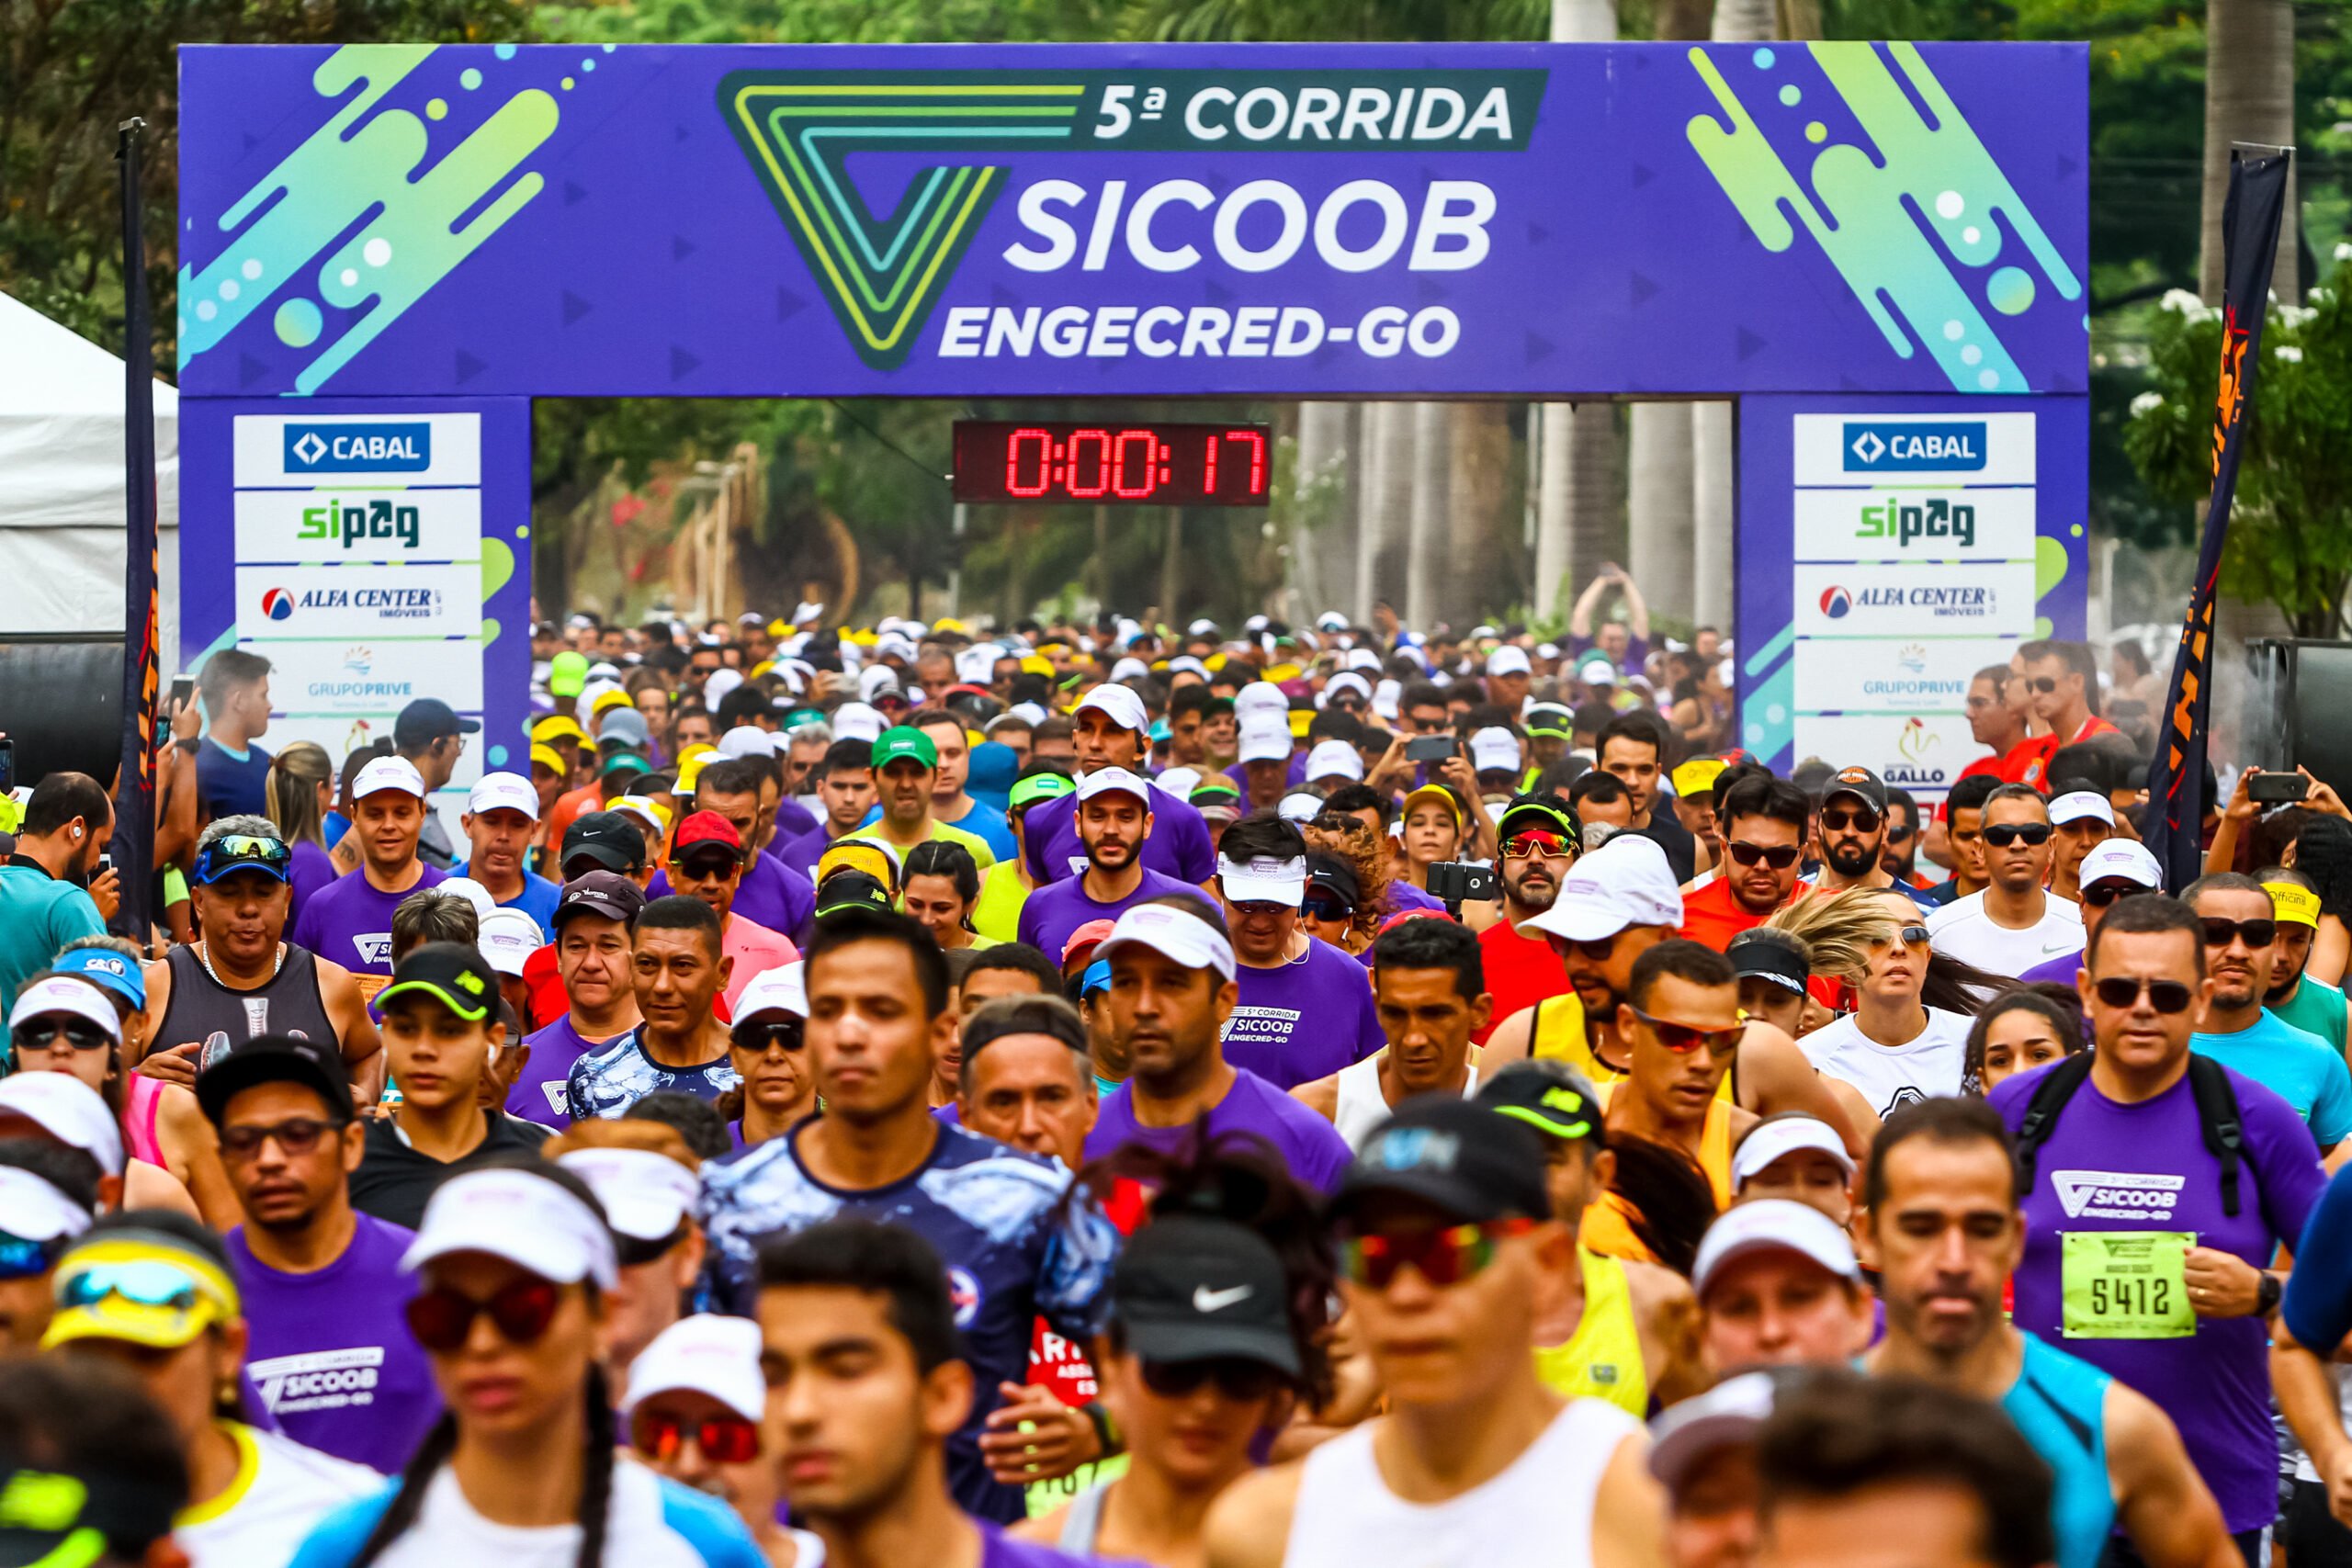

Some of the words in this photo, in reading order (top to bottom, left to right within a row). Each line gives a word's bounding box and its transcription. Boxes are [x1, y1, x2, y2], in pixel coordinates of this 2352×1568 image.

[1094, 85, 1166, 138] 5ª
[1185, 87, 1512, 140] CORRIDA
[1002, 179, 1497, 272] SICOOB
[938, 306, 1460, 357] ENGECRED-GO
[334, 436, 420, 459] CABAL
[1891, 435, 1976, 458] CABAL
[300, 589, 347, 607] ALFA
[355, 589, 431, 607] CENTER
[1857, 587, 1904, 605] ALFA
[1910, 587, 1985, 606] CENTER
[1883, 769, 1944, 783] GALLO
[1257, 1009, 1296, 1019] CORRIDA
[1236, 1019, 1294, 1033] SICOOB
[1227, 1033, 1288, 1043] ENGECRED-GO
[2092, 1189, 2177, 1207] SICOOB
[2092, 1278, 2169, 1315] 5412
[286, 1368, 378, 1396] SICOOB
